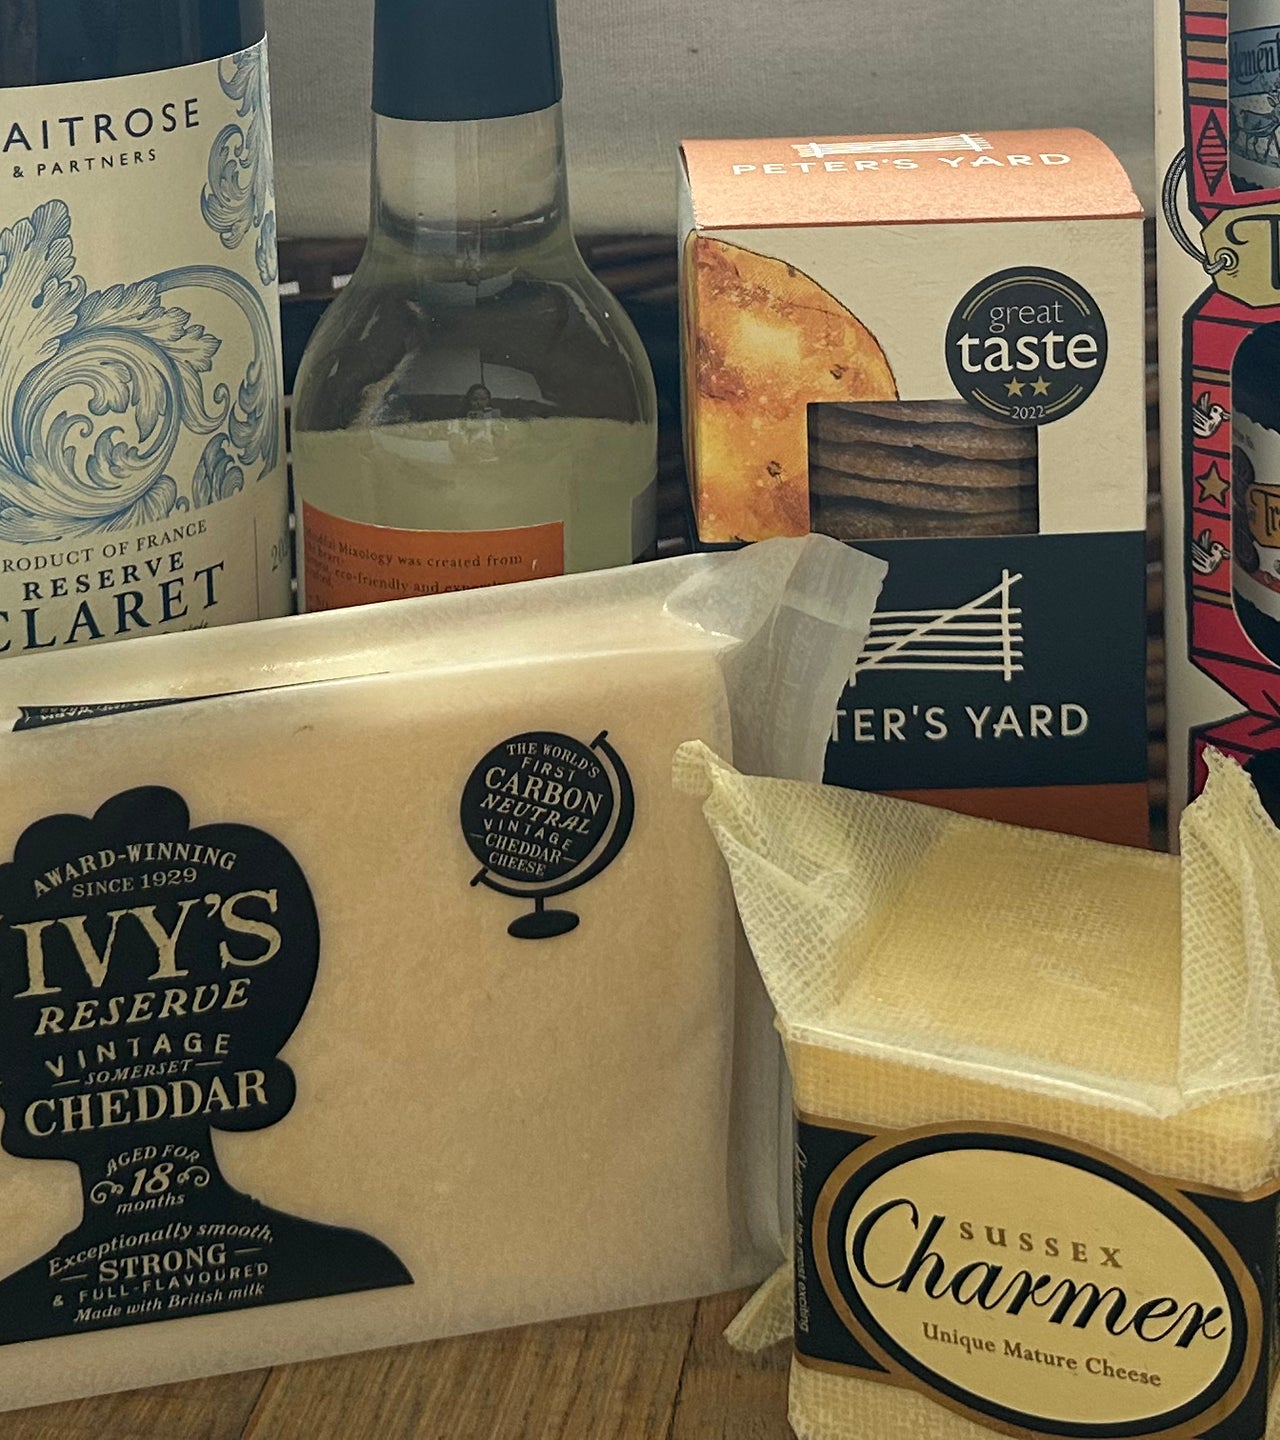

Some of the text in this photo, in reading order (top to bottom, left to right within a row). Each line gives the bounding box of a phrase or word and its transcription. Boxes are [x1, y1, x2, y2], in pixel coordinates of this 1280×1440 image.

[13, 148, 157, 178] & PARTNERS
[733, 153, 1072, 176] PETER'S YARD
[990, 300, 1063, 333] great
[956, 329, 1098, 374] taste
[1011, 405, 1046, 421] 2022
[103, 540, 129, 558] OF
[137, 519, 208, 552] FRANCE
[339, 541, 523, 568] Mixology was created from
[22, 551, 184, 601] RESERVE
[335, 568, 409, 594] eco-friendly
[413, 580, 440, 594] and
[832, 703, 1090, 741] TER'S YARD
[507, 741, 600, 778] THE WORLD'S
[522, 757, 577, 783] FIRST
[485, 766, 603, 816] CARBON
[480, 793, 592, 835] NEUTRAL
[483, 818, 573, 852] VINTAGE
[485, 833, 562, 864] CHEDDAR
[31, 842, 237, 898] AWARD-WINNING
[72, 867, 198, 899] SINCE 1929
[489, 852, 547, 877] CHEESE
[10, 887, 282, 999] IVY'S
[34, 978, 252, 1037] RESERVE
[45, 1033, 232, 1078] VINTAGE
[84, 1058, 194, 1087] SOMERSET
[24, 1069, 269, 1137] CHEDDAR
[106, 1144, 200, 1177] AGED FOR
[131, 1162, 174, 1197] 18
[116, 1192, 185, 1215] months
[48, 1222, 273, 1277] Exceptionally smooth,
[99, 1243, 227, 1283] STRONG
[796, 1245, 807, 1280] most
[959, 1221, 1123, 1269] SUSSEX
[52, 1262, 269, 1307] & FULL-FLAVOURED
[852, 1198, 1228, 1349] Charmer
[73, 1282, 264, 1323] Made with British milk
[797, 1280, 810, 1334] exciting
[921, 1321, 1162, 1389] Unique Mature Cheese
